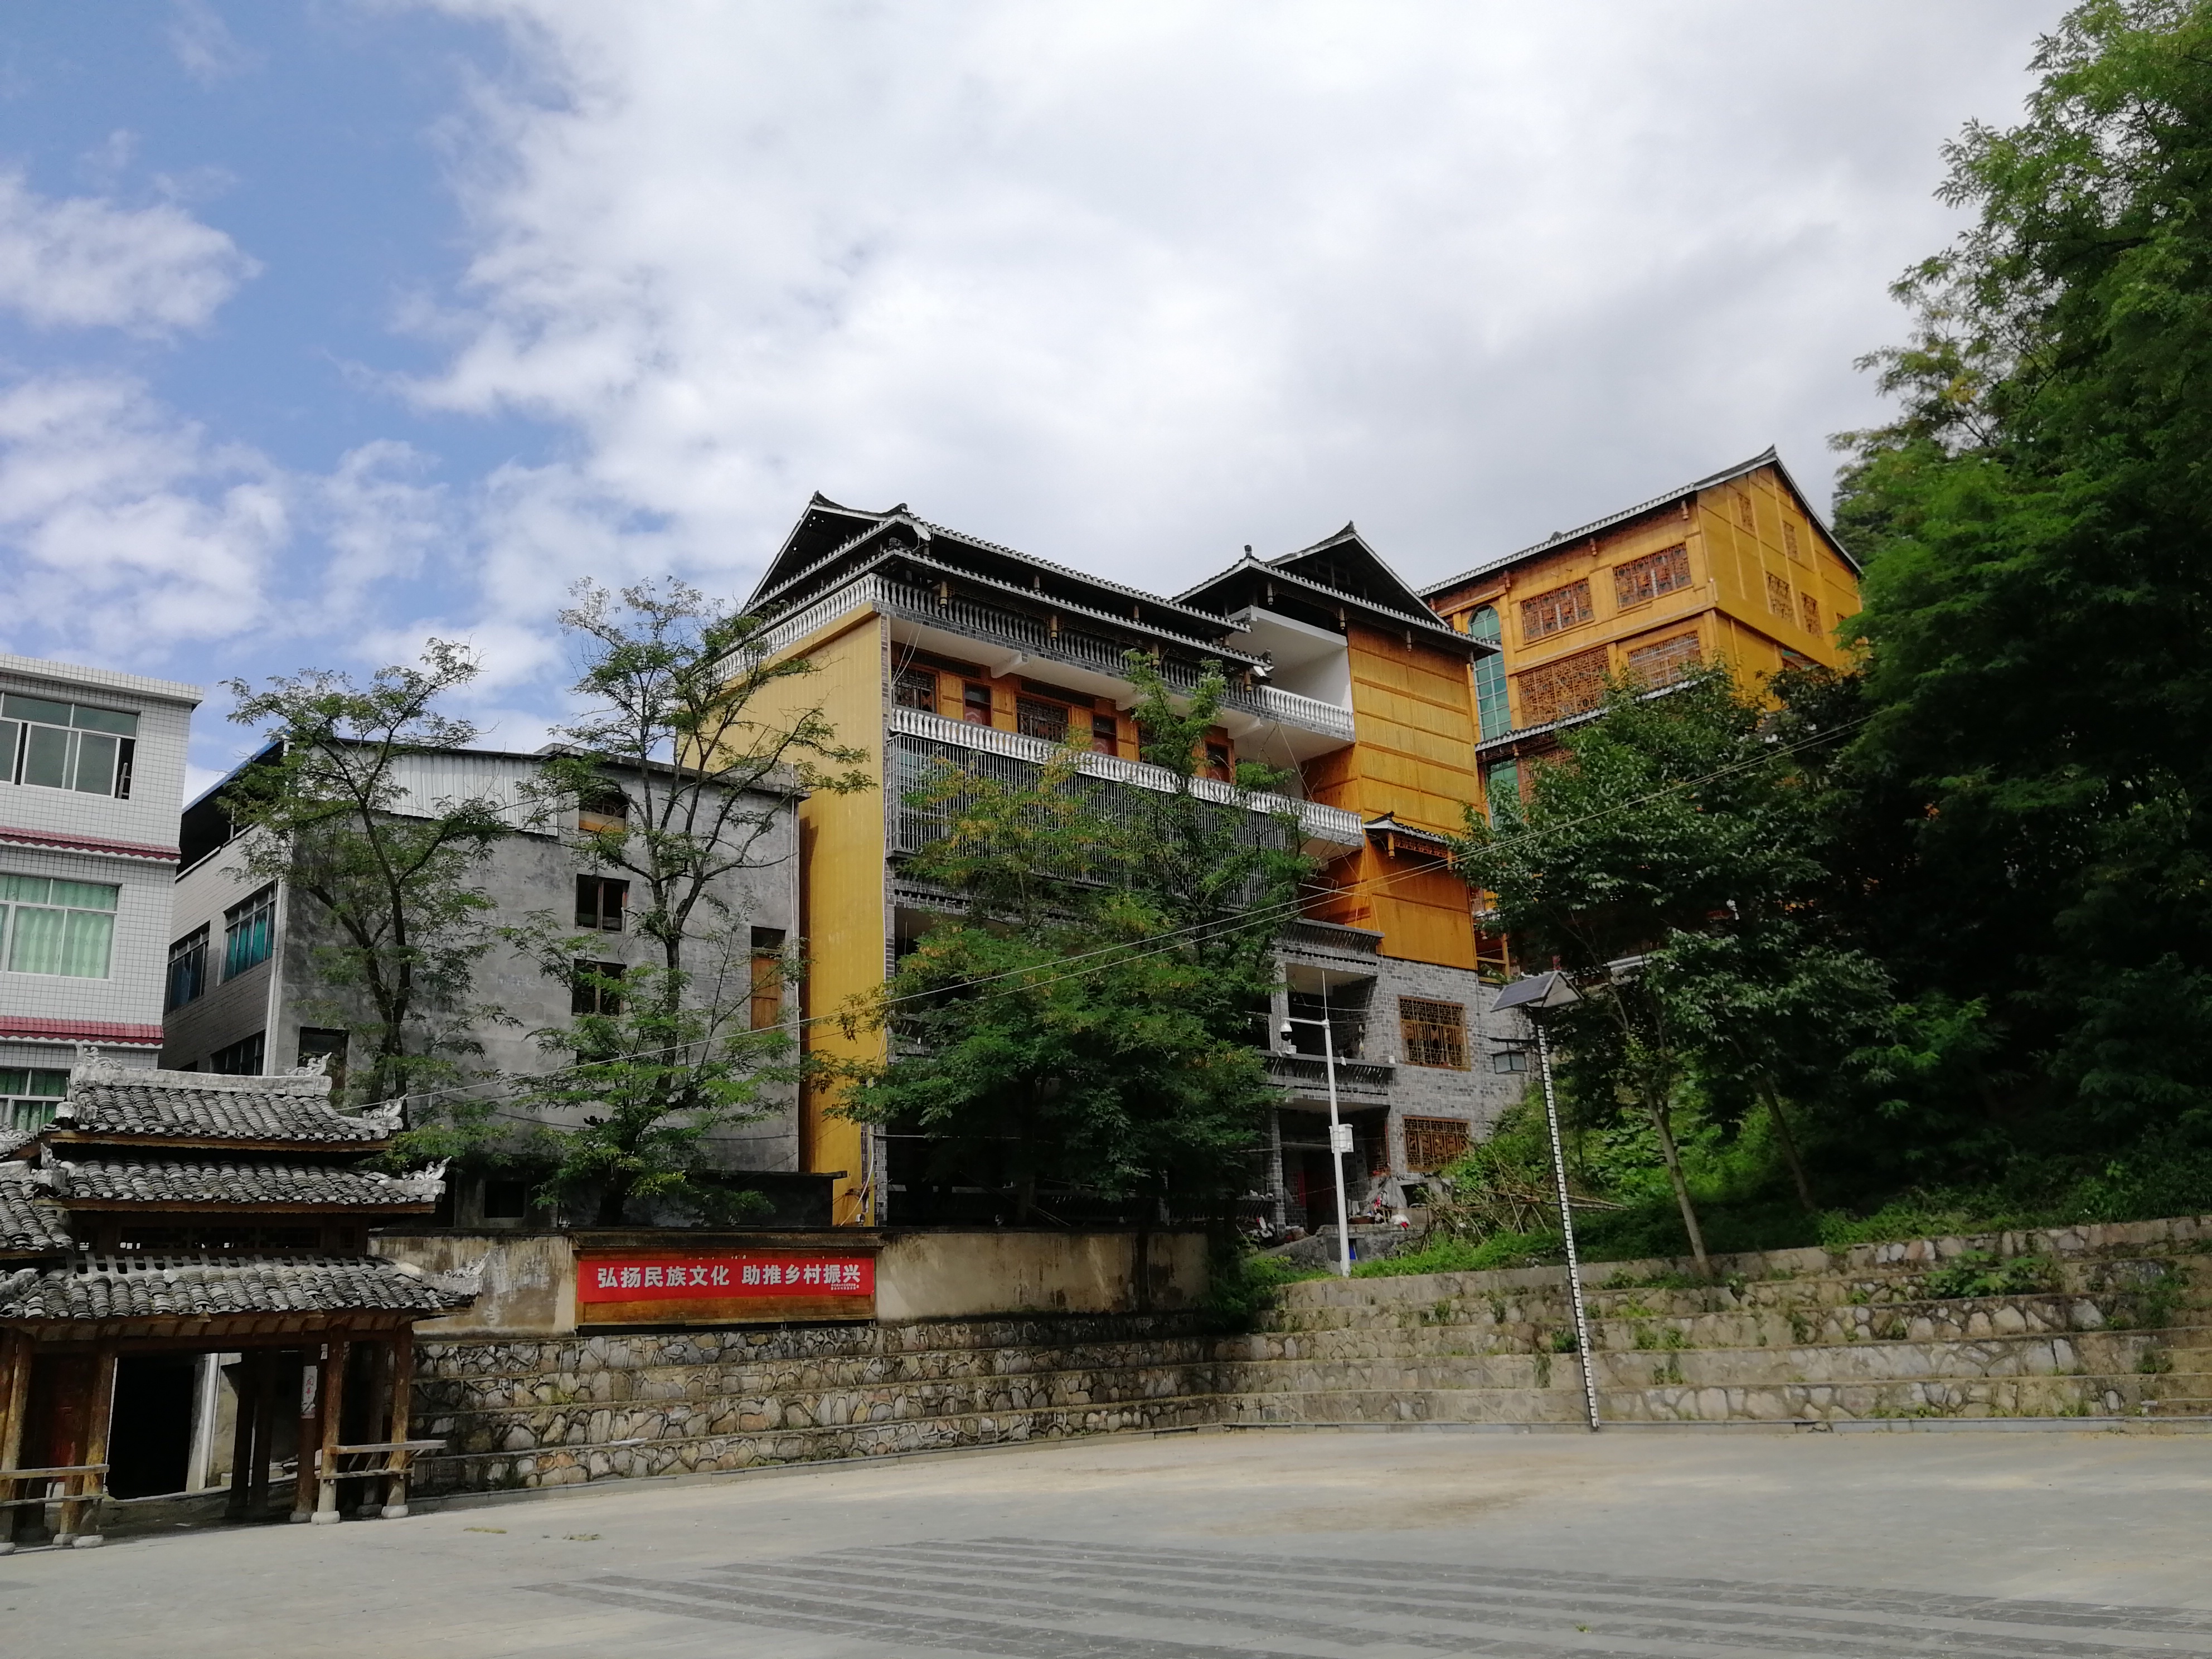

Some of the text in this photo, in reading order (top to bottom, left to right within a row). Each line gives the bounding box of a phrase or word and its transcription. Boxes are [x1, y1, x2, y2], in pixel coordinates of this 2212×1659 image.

[598, 1264, 861, 1288] 弘扬民族文化 助推乡村振兴
